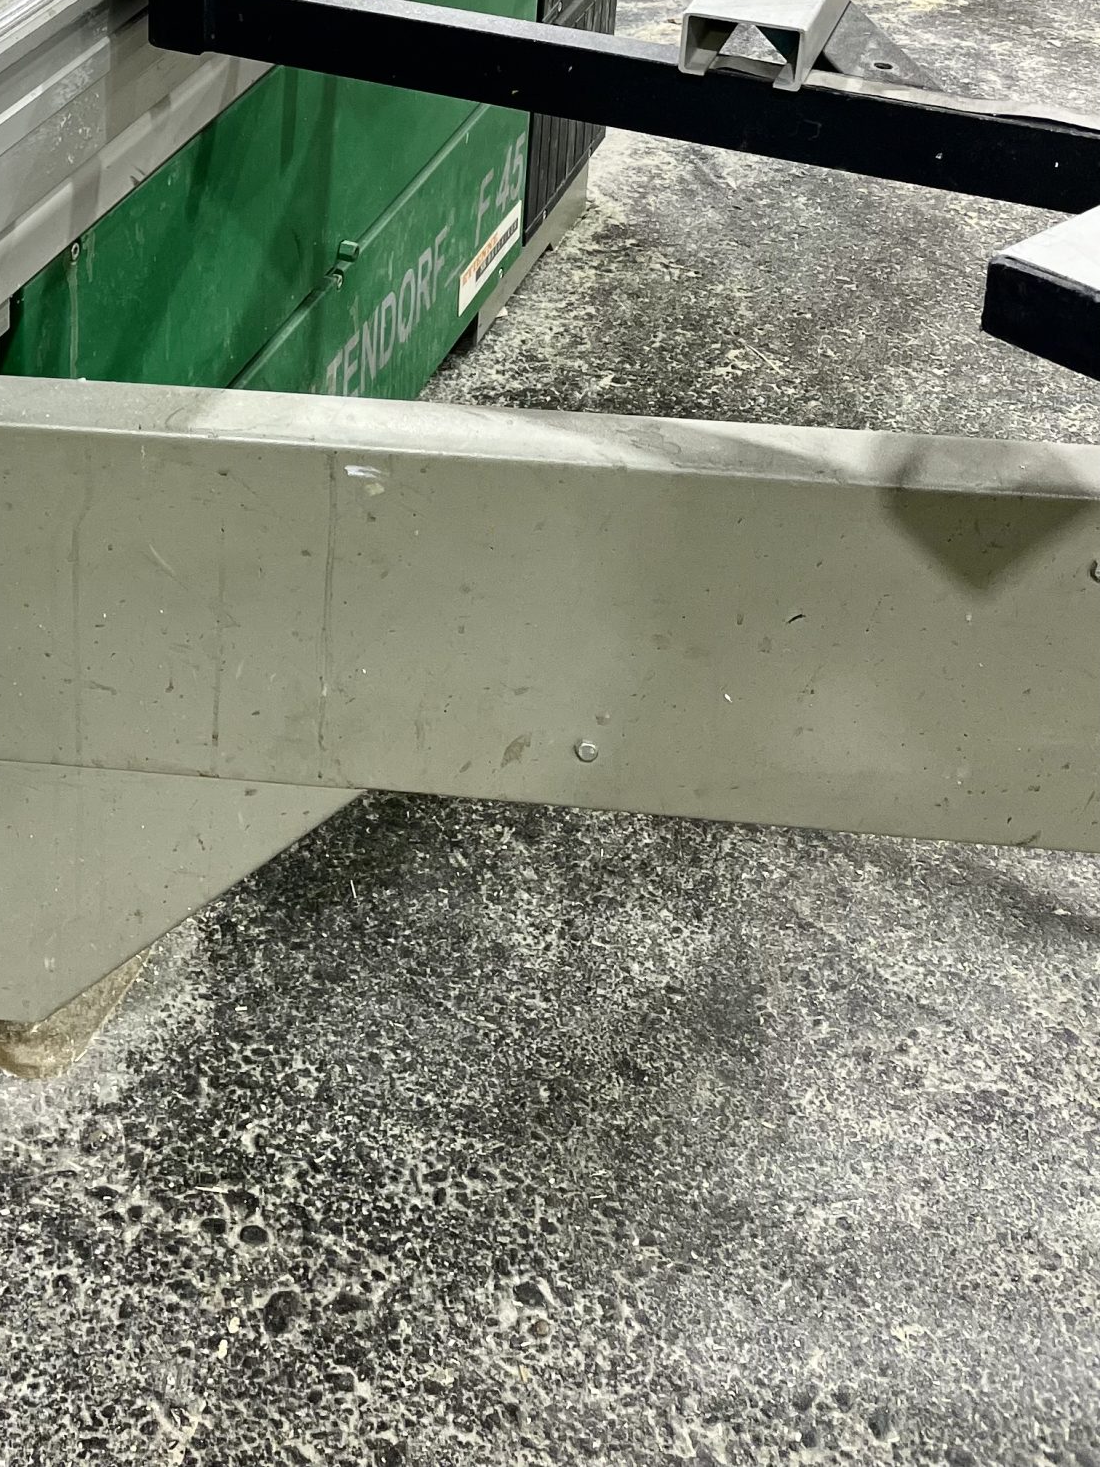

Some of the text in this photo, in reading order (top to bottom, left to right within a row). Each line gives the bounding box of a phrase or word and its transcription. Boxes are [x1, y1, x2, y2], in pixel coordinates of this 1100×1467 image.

[326, 225, 449, 396] TENDORF
[474, 167, 495, 248] F
[495, 131, 527, 213] 45
